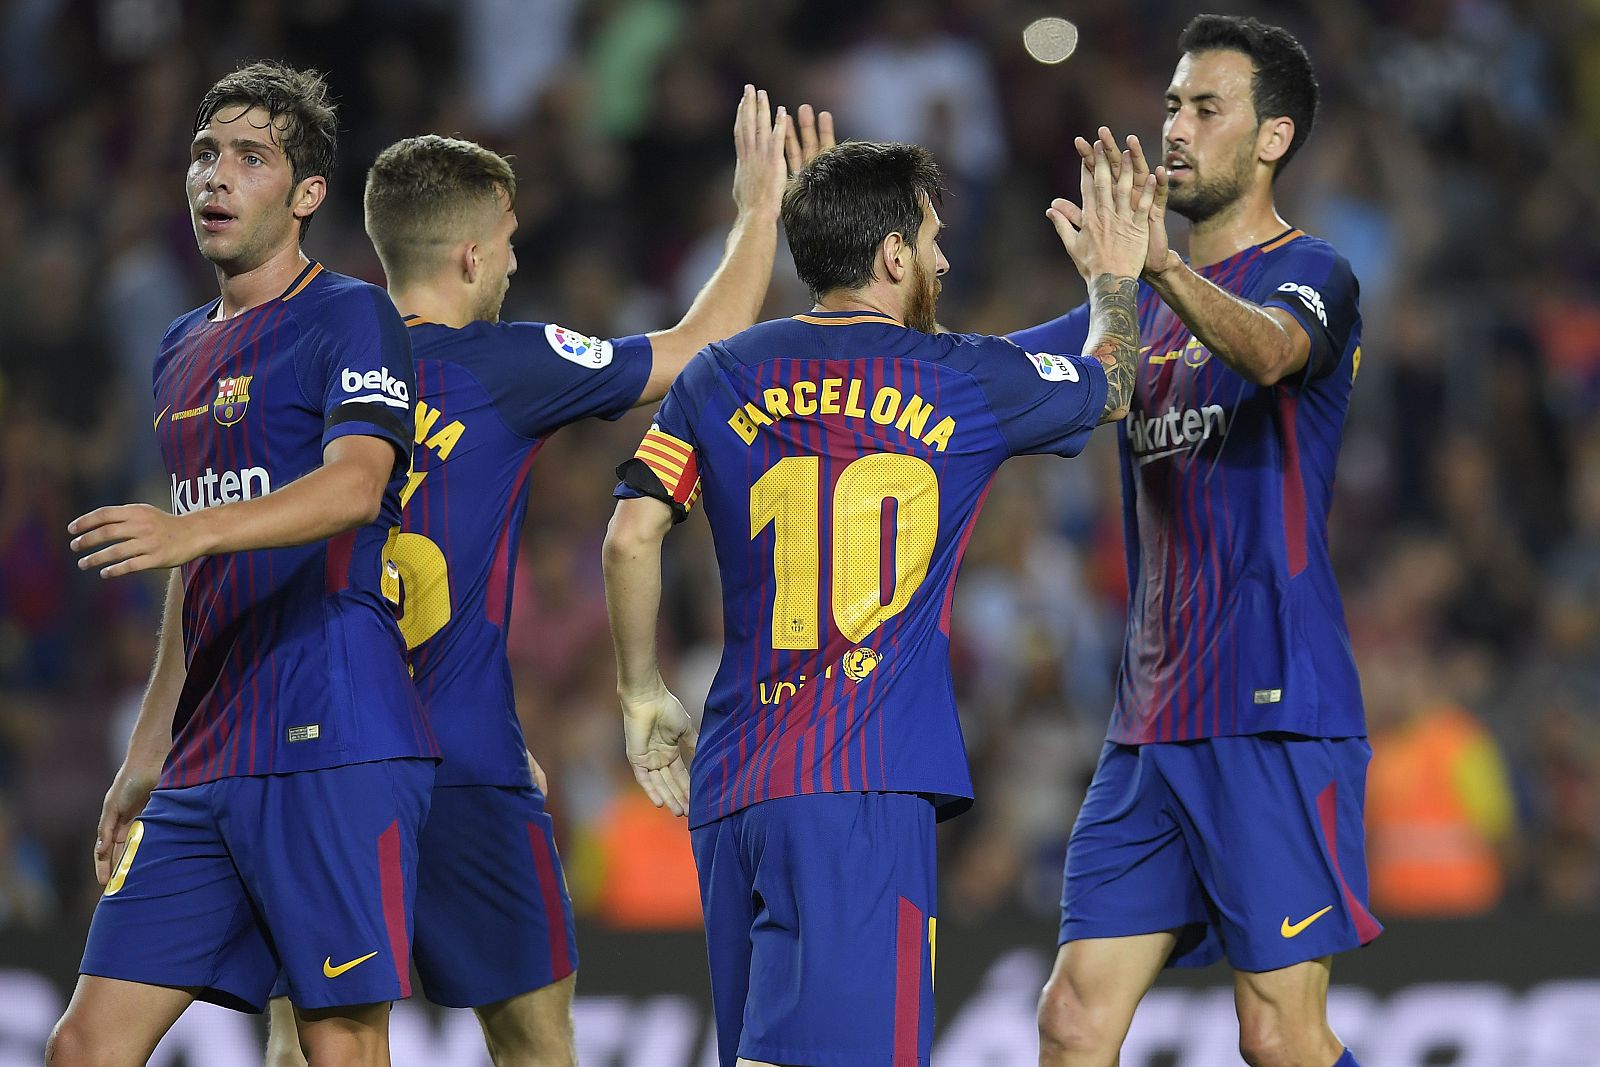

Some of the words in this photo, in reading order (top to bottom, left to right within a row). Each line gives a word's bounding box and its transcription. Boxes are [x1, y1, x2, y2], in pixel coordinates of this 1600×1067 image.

[341, 367, 409, 402] beko
[728, 378, 956, 452] BARCELONA
[170, 466, 270, 516] kuten
[750, 452, 939, 650] 10
